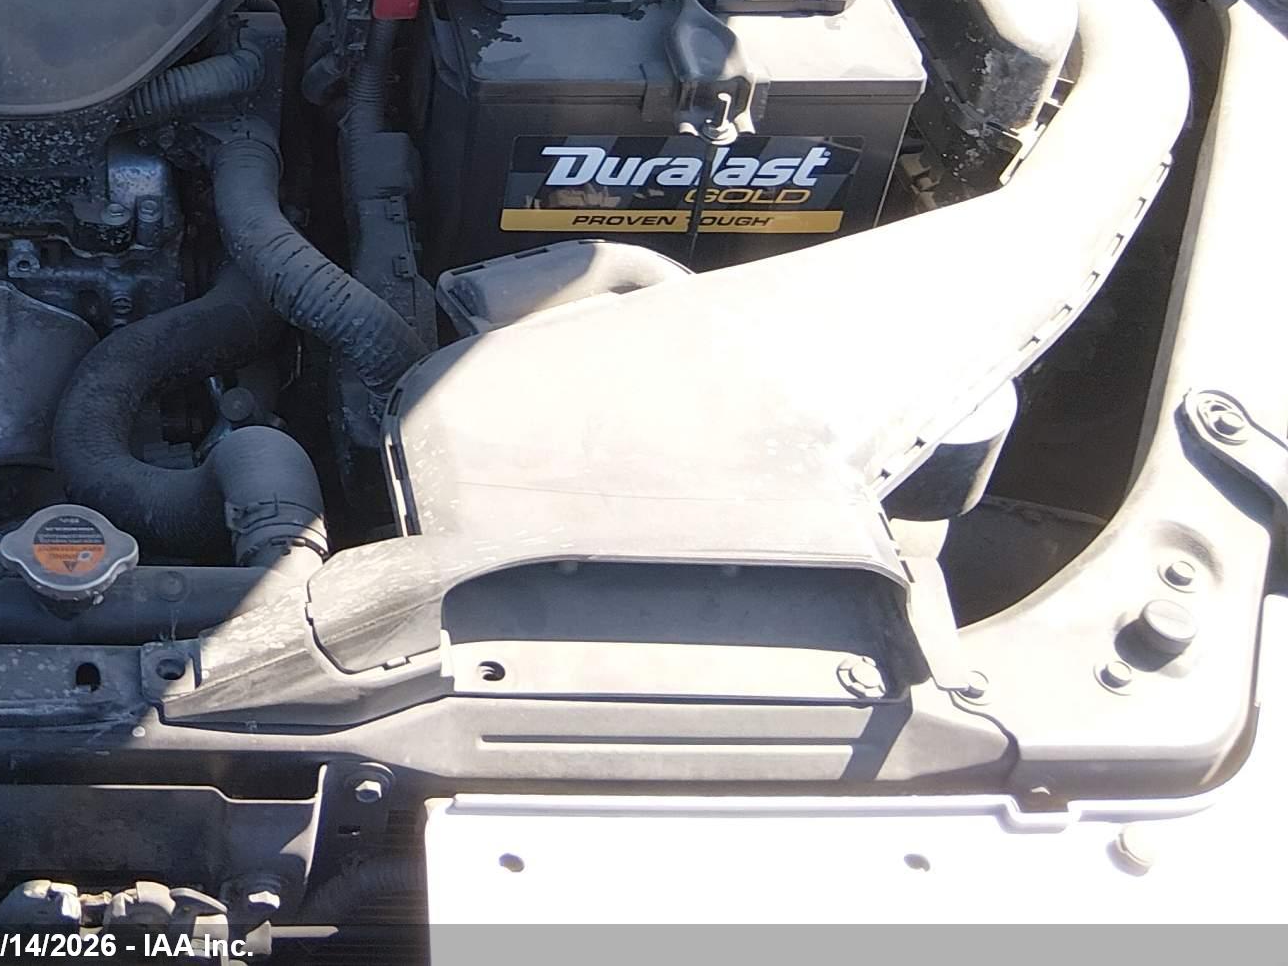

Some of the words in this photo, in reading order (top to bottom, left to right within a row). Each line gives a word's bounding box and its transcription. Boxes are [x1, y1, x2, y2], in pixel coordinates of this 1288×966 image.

[541, 146, 831, 187] Duralast
[684, 188, 811, 205] GOLD
[572, 215, 677, 227] PROVEN
